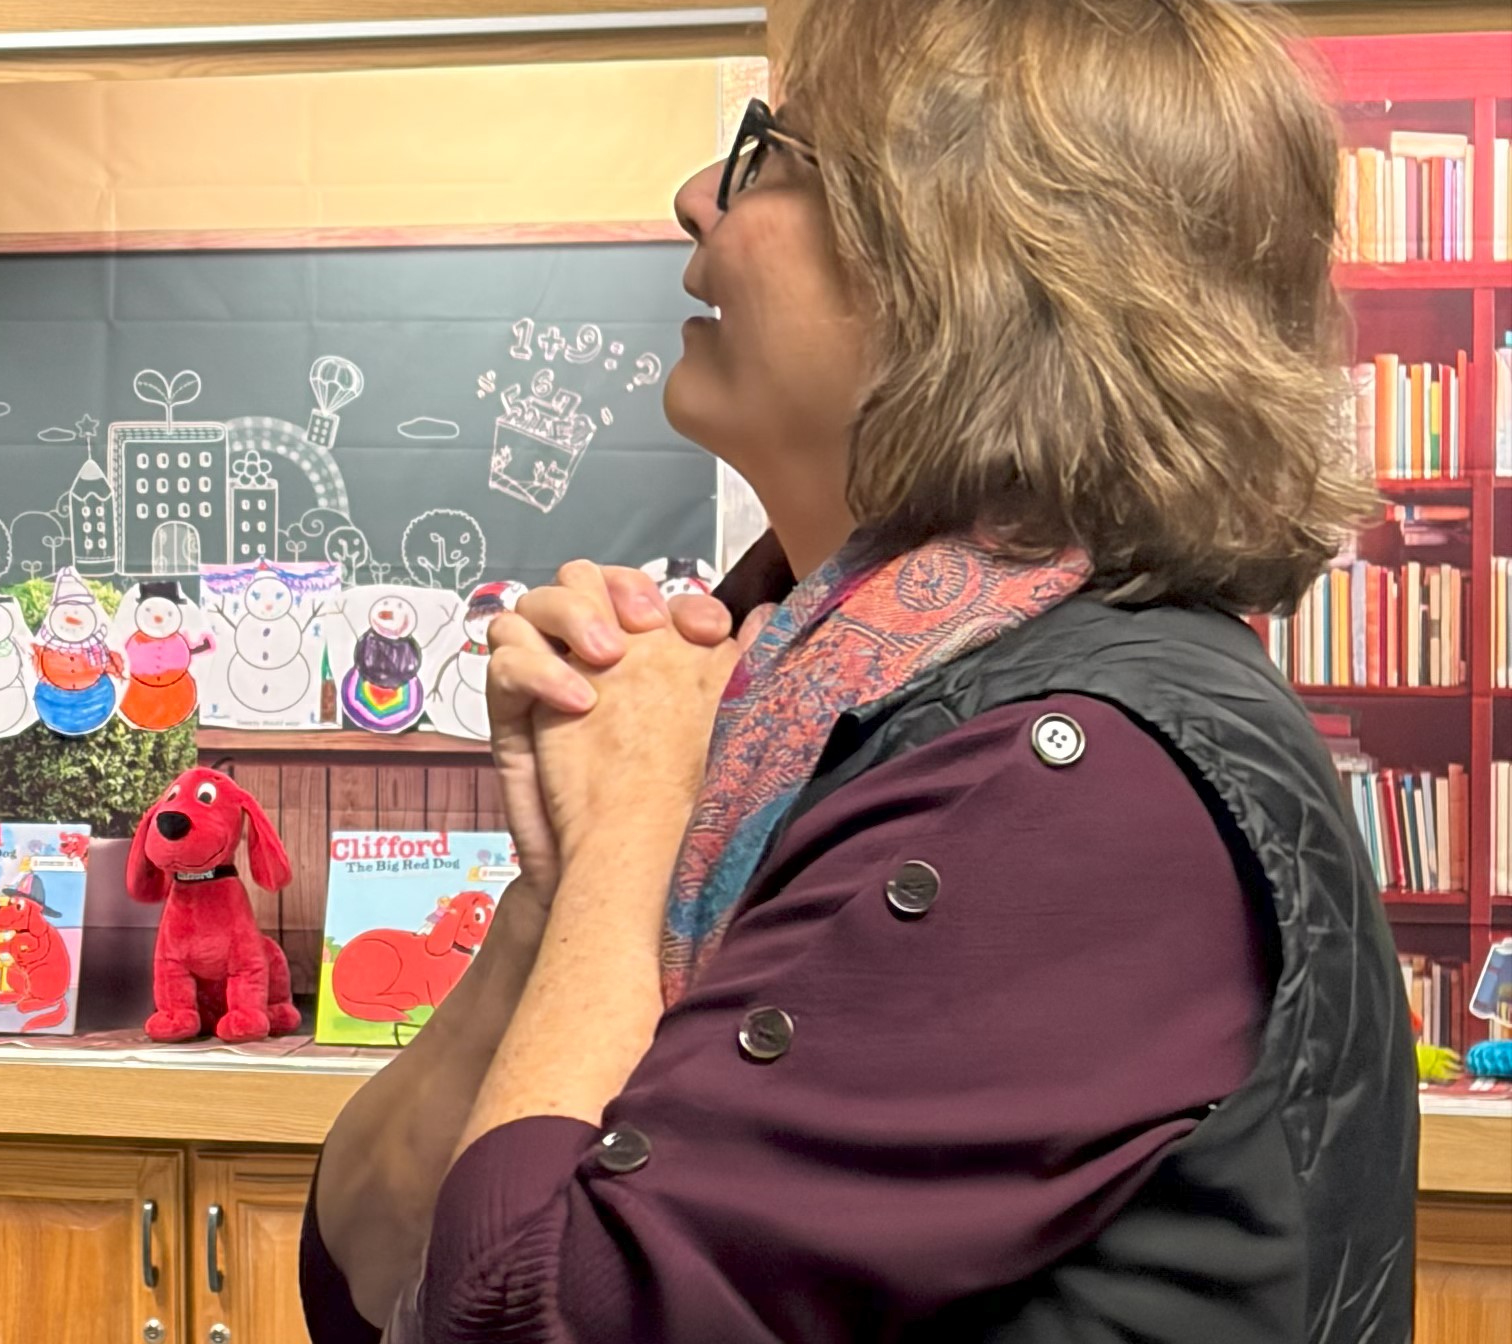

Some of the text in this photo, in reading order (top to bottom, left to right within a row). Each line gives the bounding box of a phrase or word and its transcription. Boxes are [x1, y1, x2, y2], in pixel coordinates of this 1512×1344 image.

[331, 832, 450, 860] Clifford
[346, 858, 460, 873] The Big Red Dog
